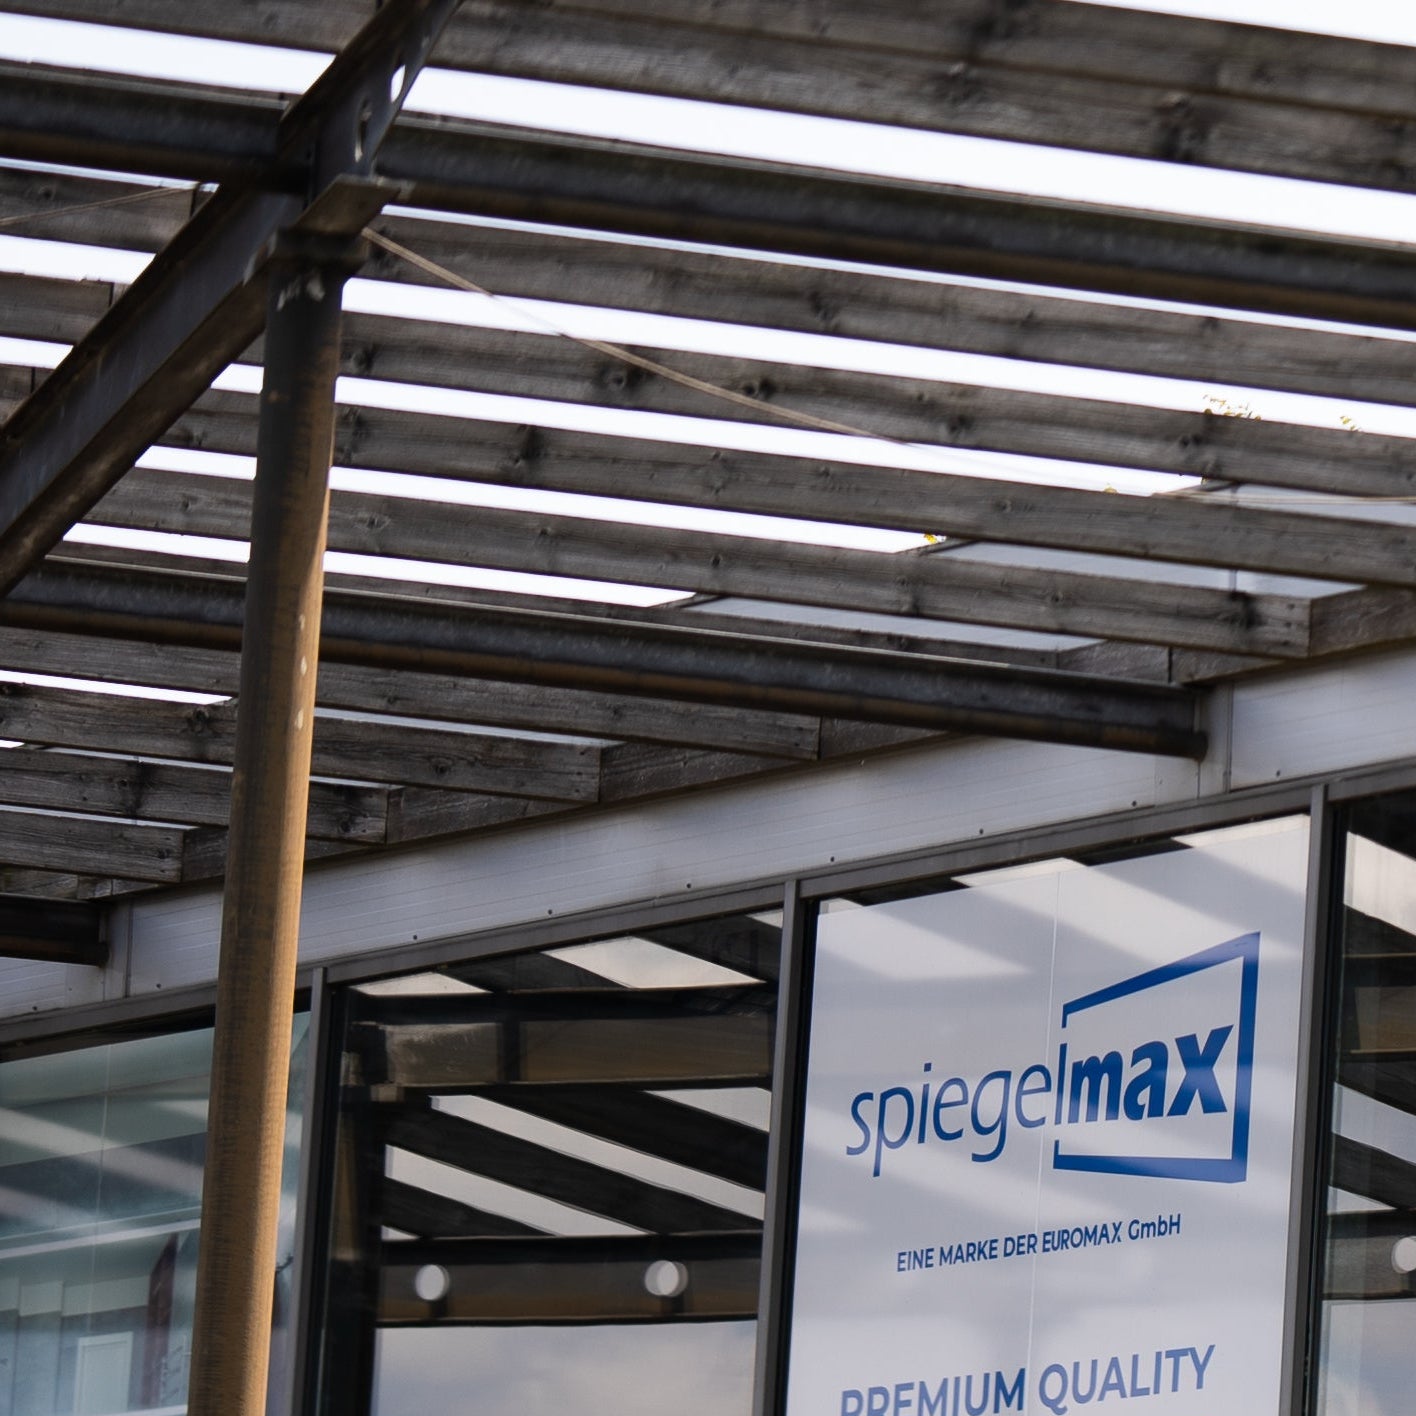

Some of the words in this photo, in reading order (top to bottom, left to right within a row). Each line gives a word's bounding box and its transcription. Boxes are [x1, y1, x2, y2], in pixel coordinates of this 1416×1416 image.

[846, 1024, 1234, 1178] spiegelmax
[896, 1248, 935, 1273] EINE
[938, 1238, 999, 1267] MARKE
[1003, 1233, 1038, 1258] DER
[1042, 1221, 1123, 1253] EUROMAX
[1128, 1213, 1181, 1241] GmbH
[1038, 1344, 1216, 1416] QUALITY
